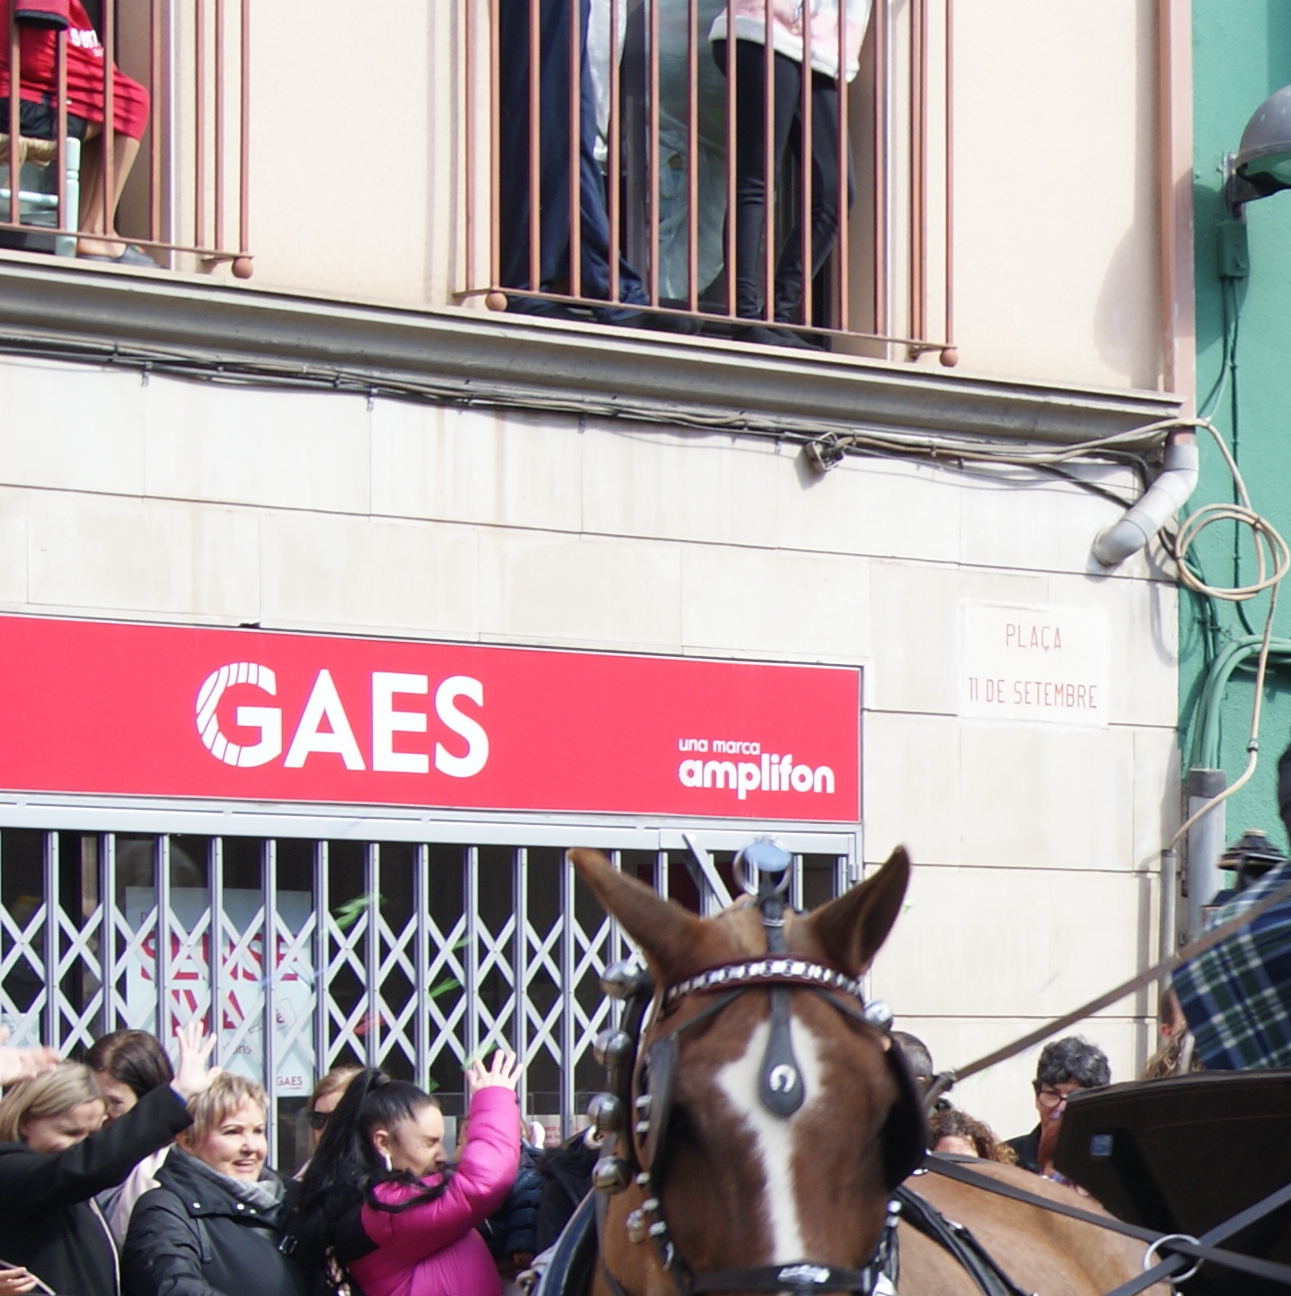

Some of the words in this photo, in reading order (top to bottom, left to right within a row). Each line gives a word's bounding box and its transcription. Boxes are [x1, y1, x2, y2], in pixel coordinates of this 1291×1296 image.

[1005, 623, 1062, 652] PLAÇA
[968, 676, 979, 702] 11
[986, 678, 1006, 704] DE
[1013, 680, 1098, 709] SETEMBRE
[196, 661, 490, 778] GAES
[678, 738, 709, 753] una
[713, 740, 761, 755] marca
[678, 753, 836, 801] amplifon
[276, 1076, 303, 1087] GAES
